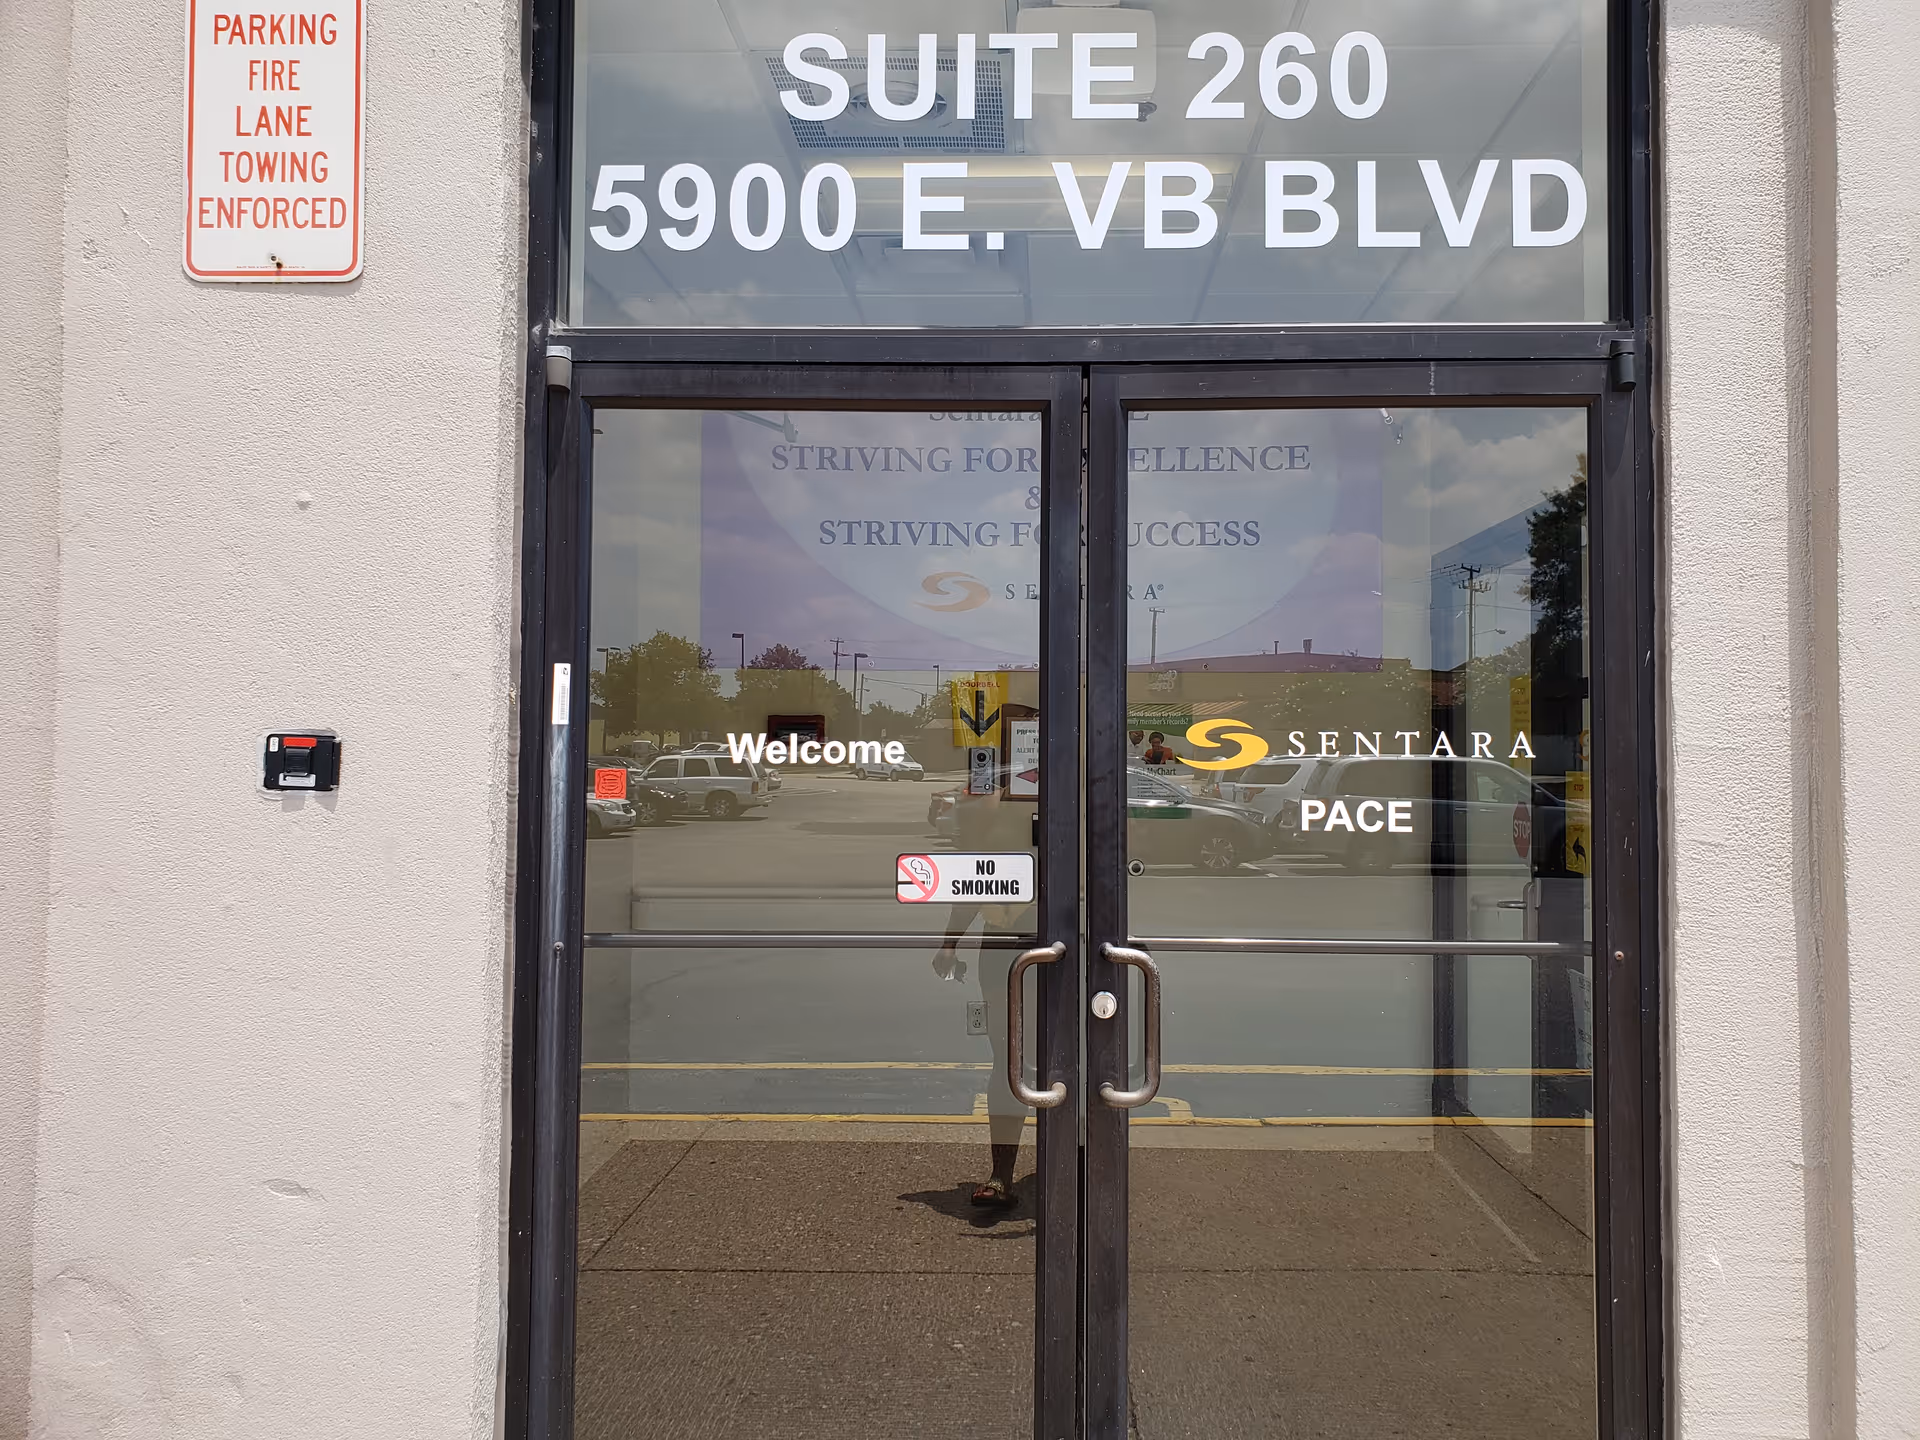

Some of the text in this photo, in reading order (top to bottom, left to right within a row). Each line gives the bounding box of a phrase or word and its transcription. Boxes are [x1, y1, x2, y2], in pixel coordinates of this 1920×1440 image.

[213, 14, 337, 45] PARKING
[249, 59, 300, 91] FIRE
[779, 31, 1388, 121] SUITE 260
[235, 105, 312, 137] LANE
[219, 151, 329, 183] TOWING
[198, 197, 347, 229] ENFORCED
[589, 159, 1588, 252] 5900 E. VB BLVD
[770, 444, 1312, 473] STRIVING FOR ELLENCE
[818, 520, 1000, 547] STRIVING
[1118, 520, 1261, 547] UCCESS
[727, 732, 906, 765] Welcome
[1287, 730, 1536, 759] SENTARA
[1301, 801, 1413, 833] PACE
[1513, 820, 1531, 838] STOP
[975, 859, 996, 876] NO
[951, 879, 1020, 896] SMOKING
